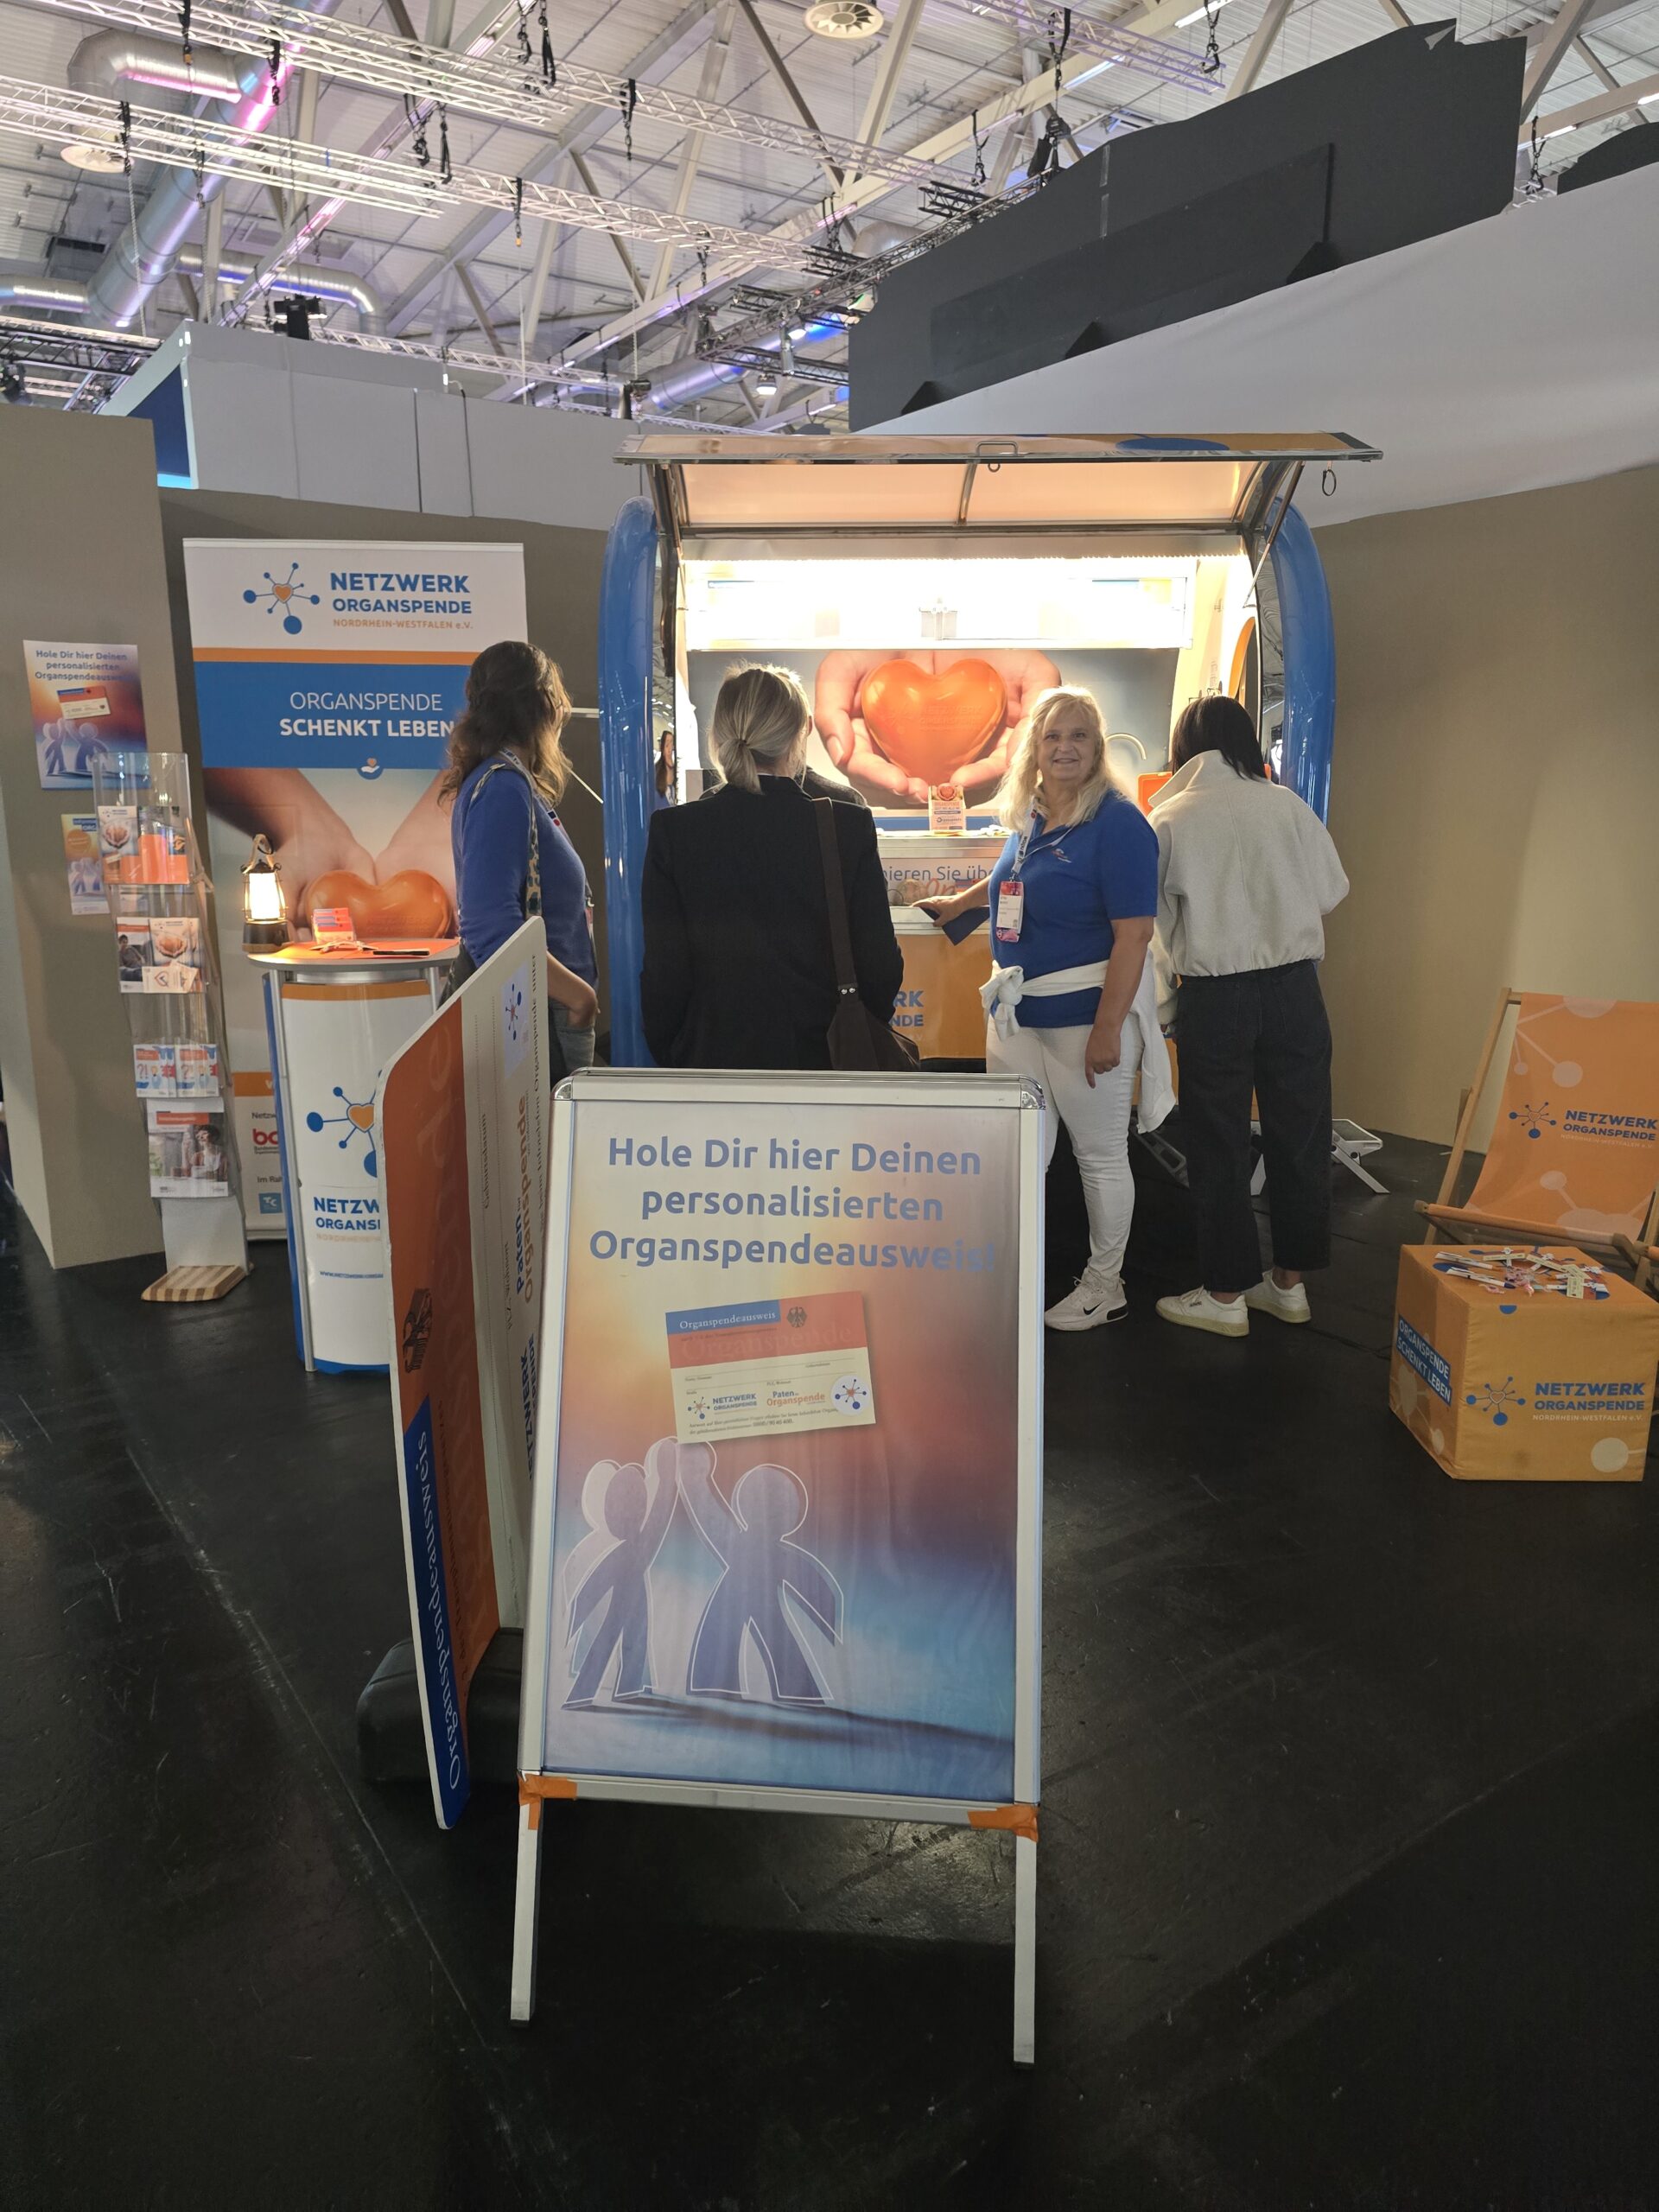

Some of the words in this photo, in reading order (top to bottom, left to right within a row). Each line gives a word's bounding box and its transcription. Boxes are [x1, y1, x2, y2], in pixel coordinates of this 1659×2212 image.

[330, 572, 470, 594] NETZWERK
[332, 598, 472, 614] ORGANSPENDE
[333, 619, 453, 629] NORDRHEIN-WESTFALEN
[35, 650, 58, 658] Hole
[60, 651, 73, 659] Dir
[76, 652, 93, 660] hier
[96, 652, 128, 661] Deinen
[46, 662, 119, 671] personalisierten
[289, 691, 443, 711] ORGANSPENDE
[279, 718, 381, 737] SCHENKT
[387, 720, 454, 738] LEBEN
[937, 866, 961, 881] Sie
[1565, 1109, 1658, 1130] NETZWERK
[1563, 1123, 1656, 1141] ORGANSPENDE
[608, 1135, 692, 1168] Hole
[704, 1137, 758, 1169] Dir
[769, 1138, 840, 1171] hier
[852, 1141, 982, 1175] Deinen
[517, 1095, 534, 1304] Organspende
[642, 1185, 943, 1221] personalisierten
[515, 1214, 524, 1295] Paten
[589, 1230, 995, 1273] Organspendeausweis!
[679, 1311, 777, 1331] Organspendeausweis
[1399, 1319, 1450, 1379] ORGANSPENDE
[1397, 1337, 1427, 1376] SCHENKT
[1427, 1370, 1451, 1402] LEBEN
[712, 1393, 757, 1405] NETZWERK
[772, 1390, 795, 1399] Paten
[1535, 1382, 1645, 1396] NETZWERK
[766, 1393, 825, 1407] Organspende
[1534, 1401, 1645, 1411] ORGANSPENDE
[520, 1346, 533, 1481] ETZWERK
[415, 1430, 461, 1790] Organspendeausweis
